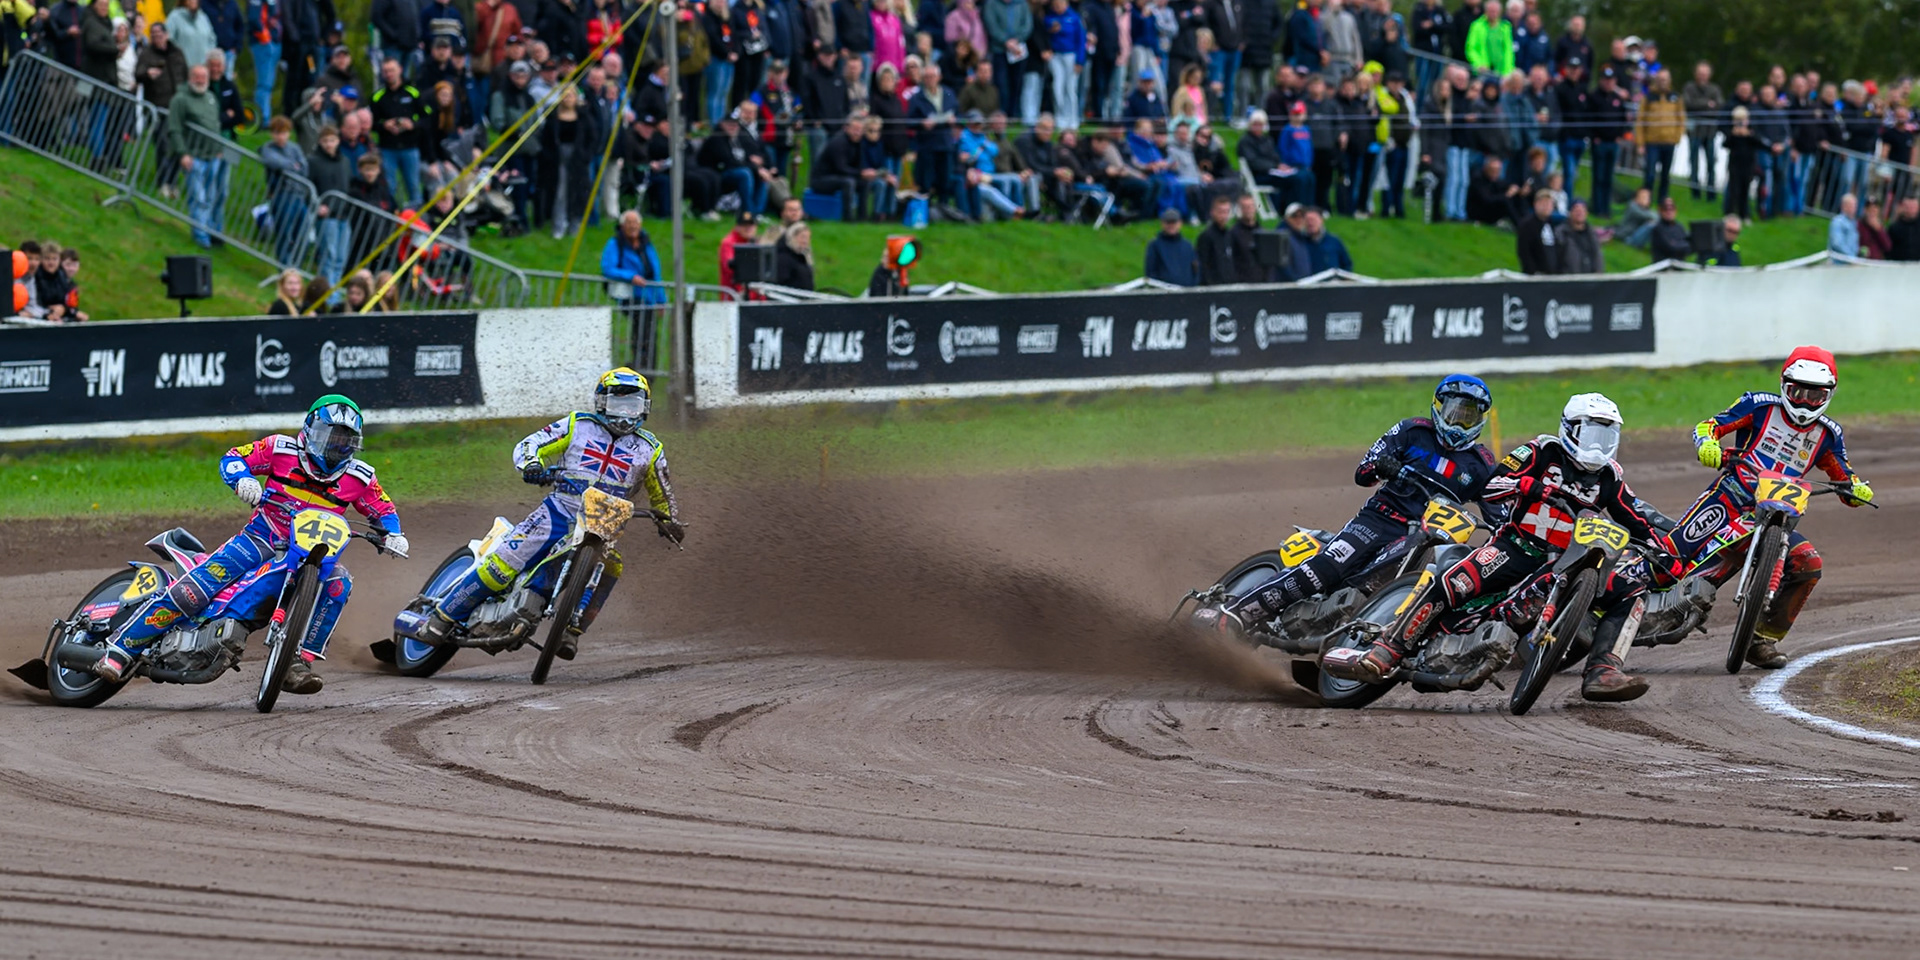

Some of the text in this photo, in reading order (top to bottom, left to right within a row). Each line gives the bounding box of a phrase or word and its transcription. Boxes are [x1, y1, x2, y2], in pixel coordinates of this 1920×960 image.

[749, 327, 783, 371] FIM
[819, 330, 865, 364] ANLAS
[1079, 316, 1115, 358] FIM
[1145, 318, 1189, 350] ANLAS
[81, 348, 126, 398] FIM
[175, 351, 227, 388] ANLAS
[1767, 480, 1802, 507] 72
[297, 519, 343, 549] 42
[1427, 505, 1472, 534] 27
[1579, 522, 1624, 546] 333
[1692, 508, 1720, 536] Arai
[1281, 534, 1317, 558] 27
[136, 570, 158, 594] 42
